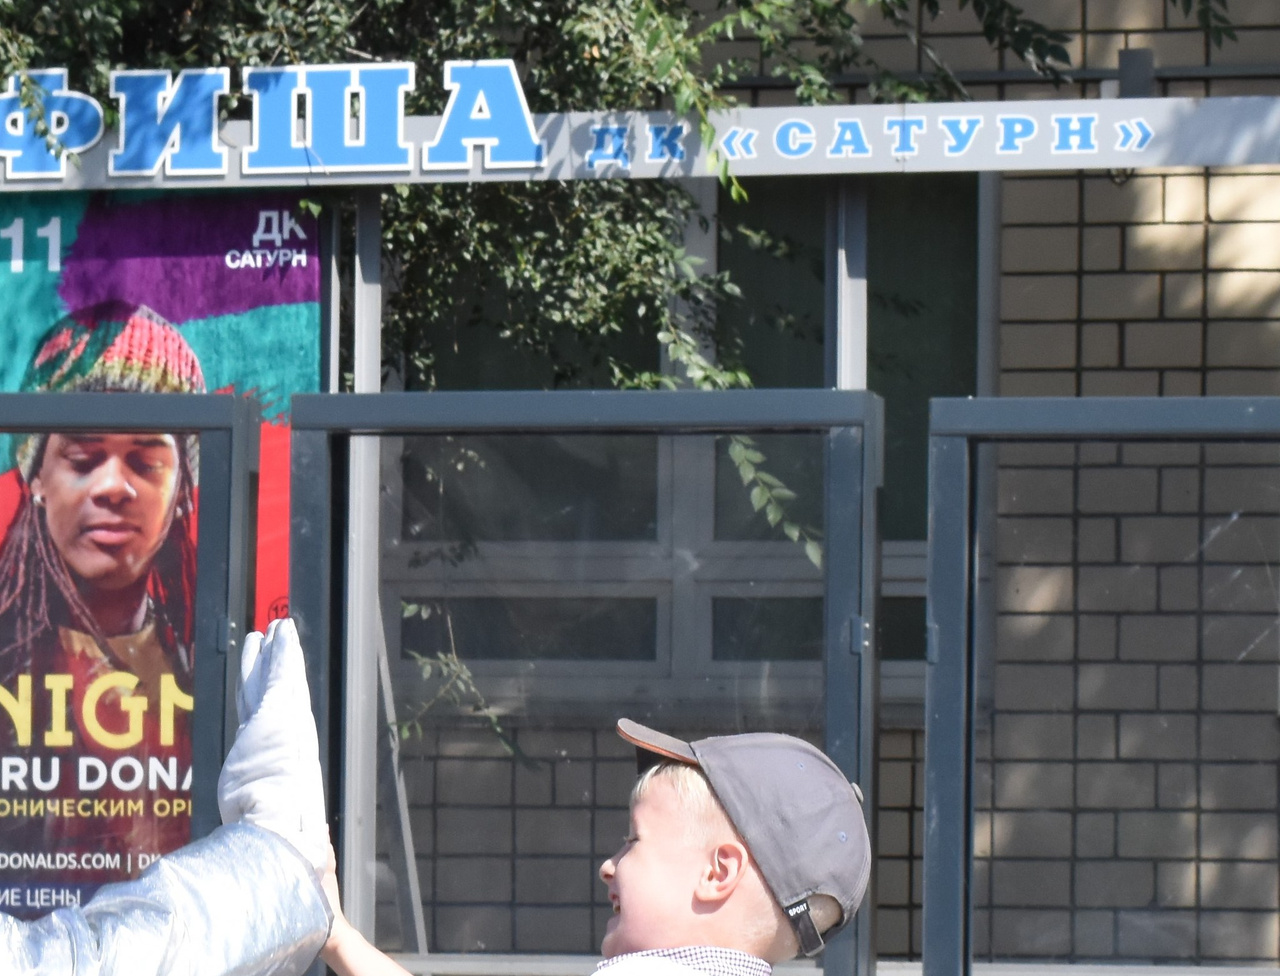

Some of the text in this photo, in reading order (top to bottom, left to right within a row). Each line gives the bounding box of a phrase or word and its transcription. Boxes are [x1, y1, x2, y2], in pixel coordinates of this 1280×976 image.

[585, 110, 1155, 170] ДК «САТУРН»
[252, 210, 308, 248] ДК
[225, 248, 308, 269] САТУРН
[25, 887, 82, 909] ЦЕНЫ
[788, 902, 808, 917] SPORT
